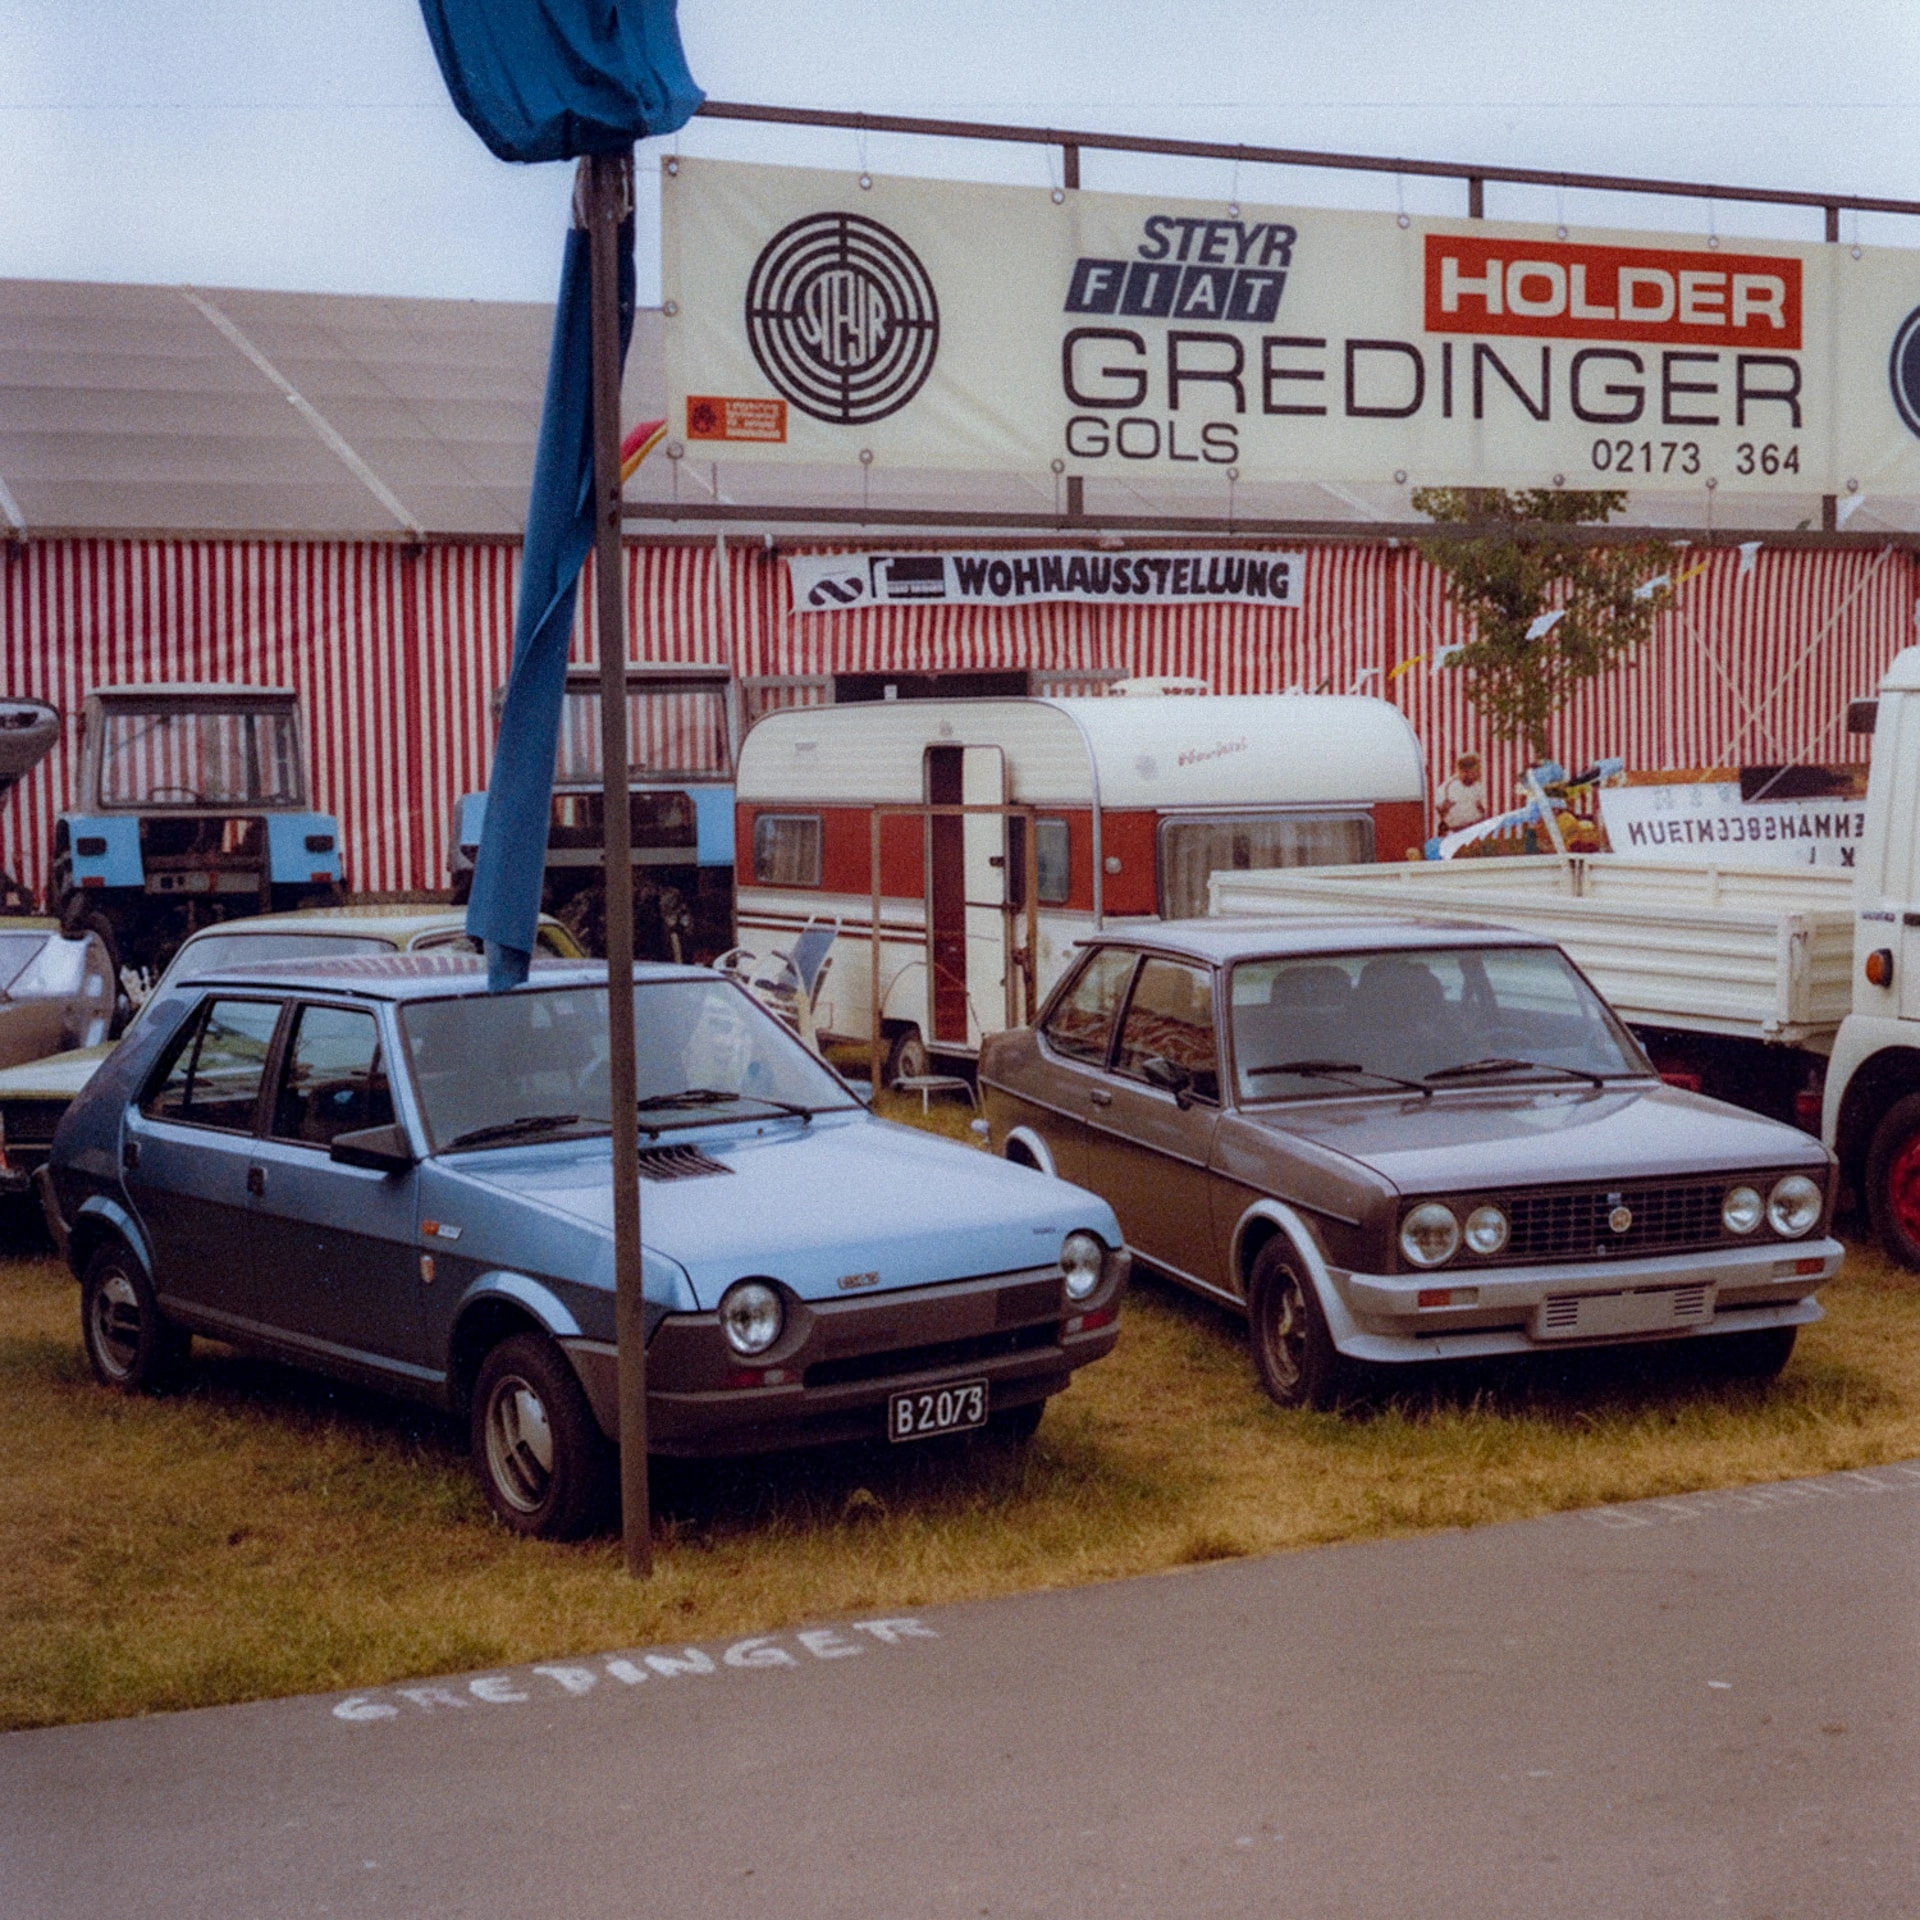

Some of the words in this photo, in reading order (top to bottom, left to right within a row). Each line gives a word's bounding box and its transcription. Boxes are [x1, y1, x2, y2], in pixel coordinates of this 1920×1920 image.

[1137, 214, 1298, 268] STEYR
[1081, 267, 1274, 315] FIAT
[1440, 256, 1787, 329] HOLDER
[1062, 326, 1803, 429] GREDINGER
[1065, 415, 1240, 465] GOLS
[1591, 438, 1701, 475] 02173
[1735, 442, 1801, 476] 364
[951, 554, 1291, 600] WOHNAUSSTELLUNG
